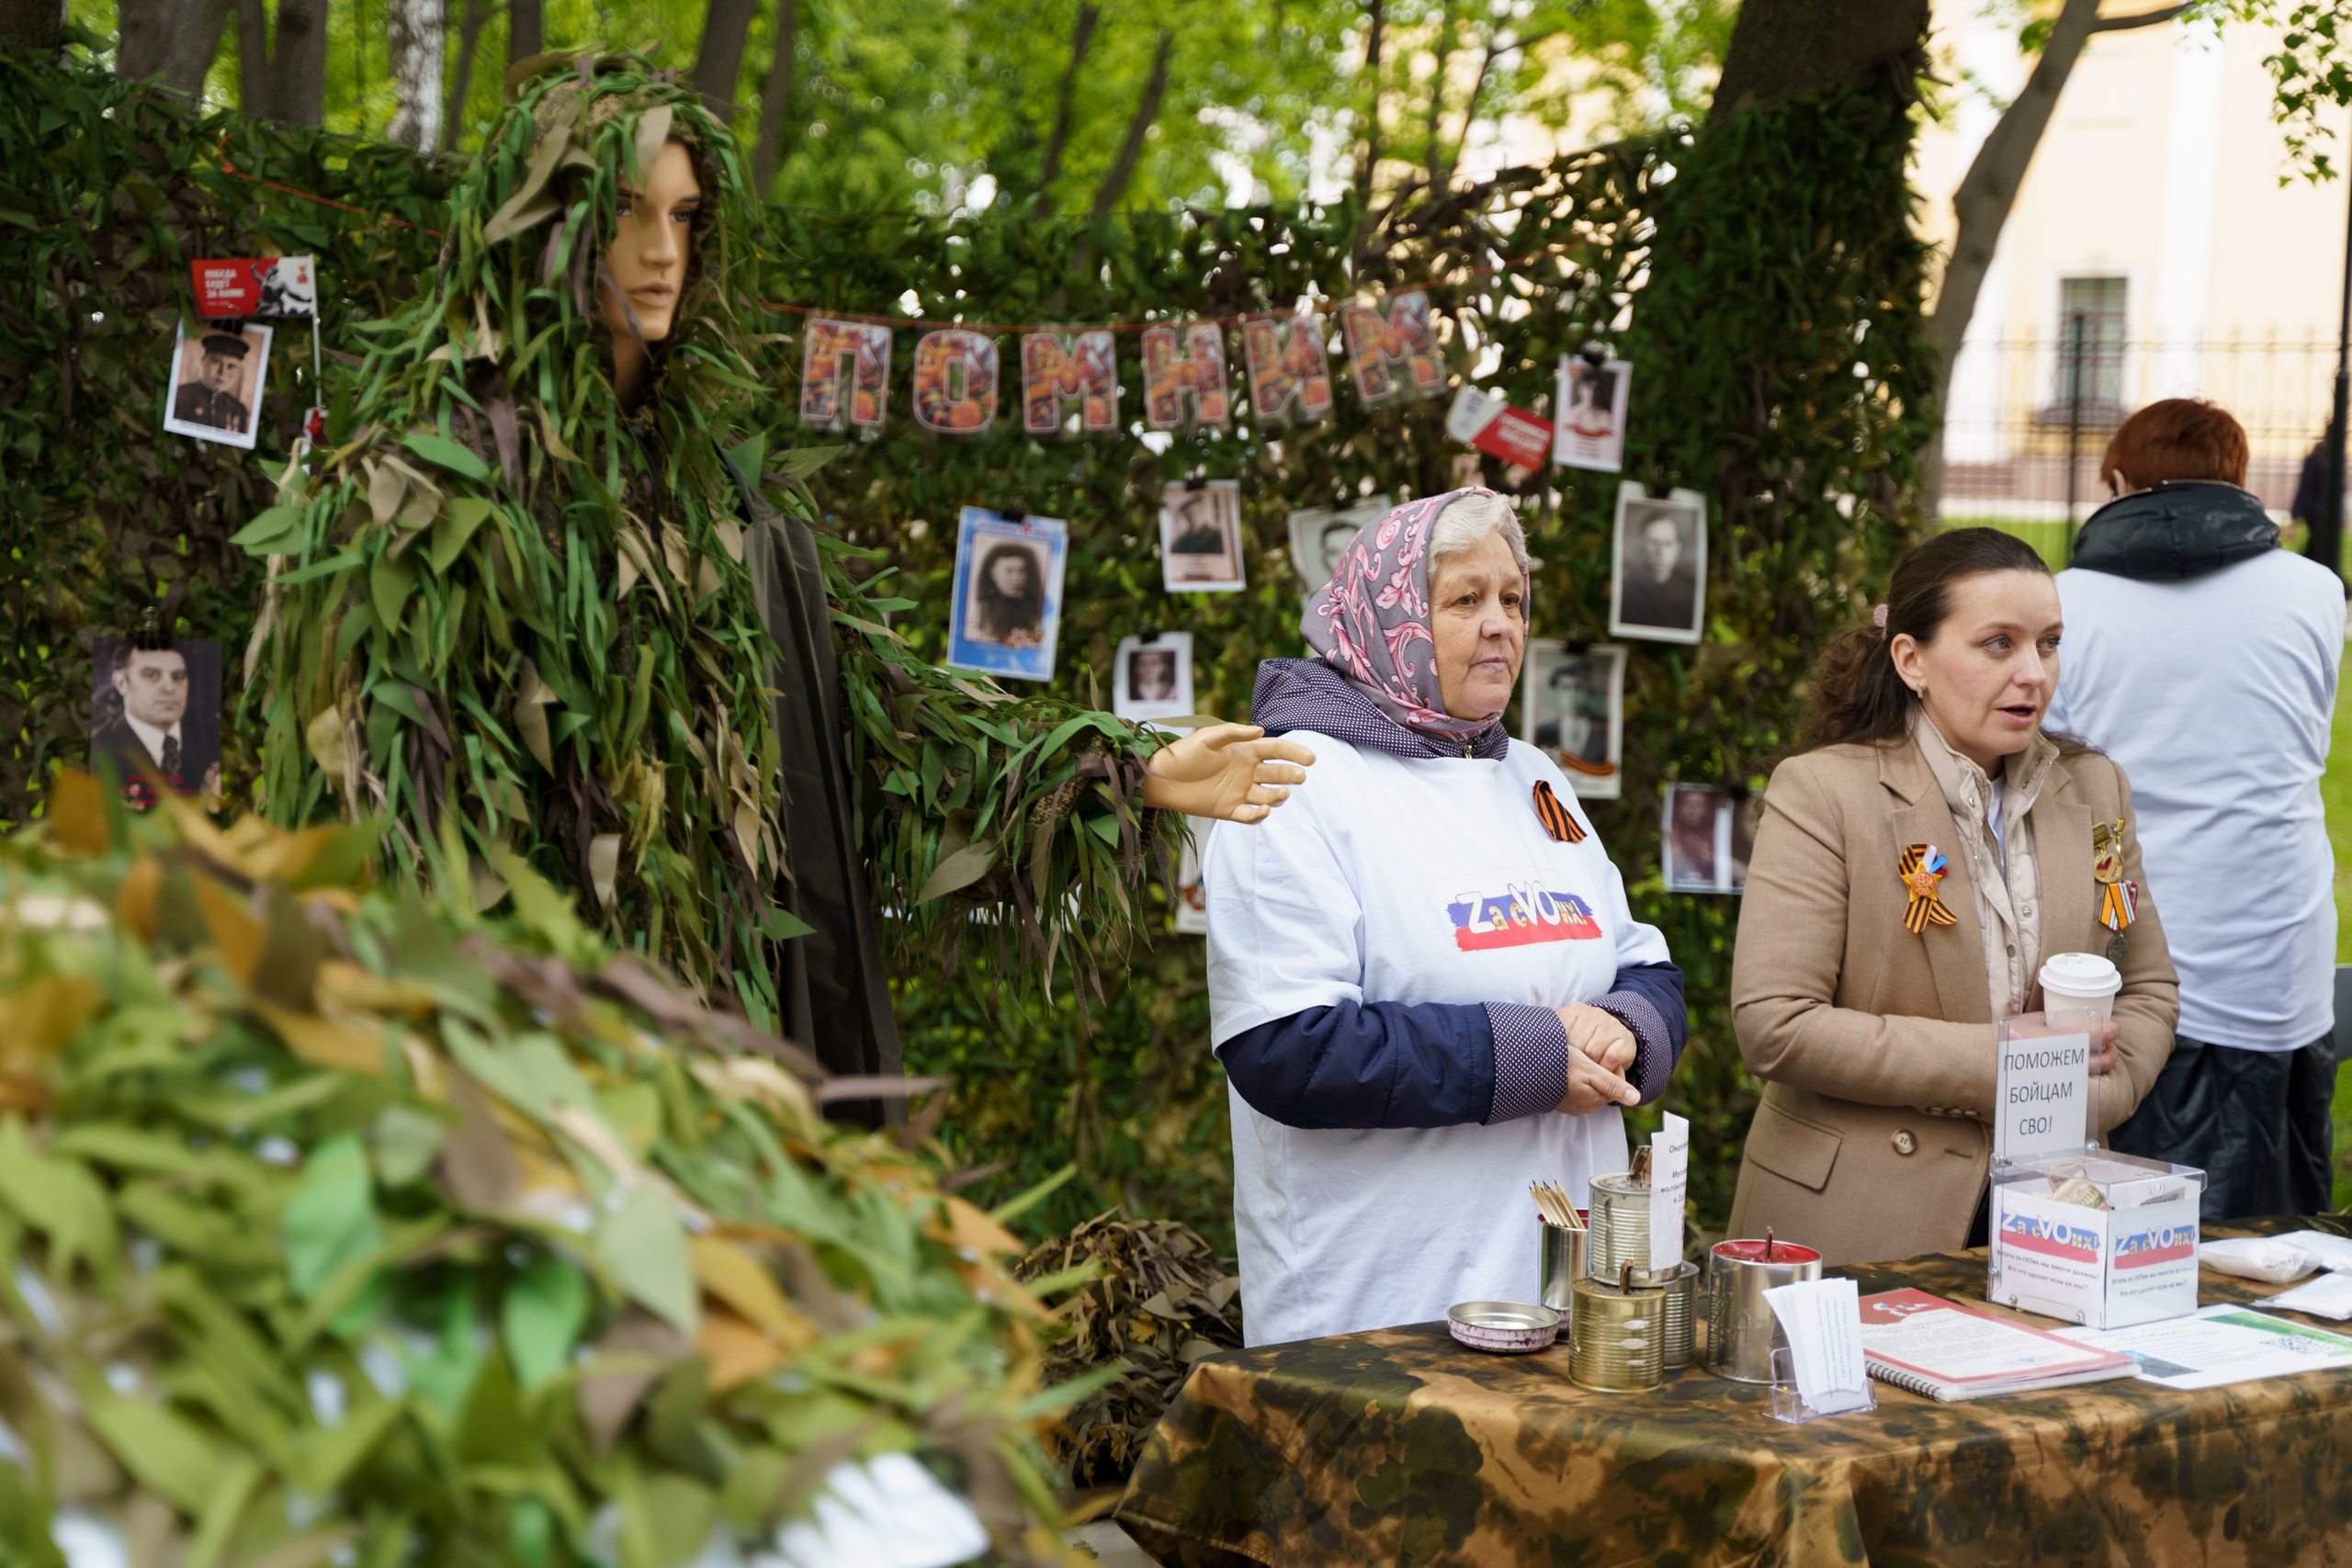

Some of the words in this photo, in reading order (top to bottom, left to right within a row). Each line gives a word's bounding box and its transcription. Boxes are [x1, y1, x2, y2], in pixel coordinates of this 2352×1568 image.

[799, 290, 1446, 434] ПОМНИМ
[2004, 1048, 2085, 1072] ПОМОЖЕМ
[2009, 1080, 2073, 1104] БОЙЦАМ
[2019, 1115, 2052, 1136] СВО!
[1996, 1249, 2015, 1259] Встать
[2052, 1264, 2072, 1274] вместе
[2007, 1265, 2018, 1273] Кто
[2028, 1270, 2050, 1281] сделает
[2050, 1277, 2064, 1285] если
